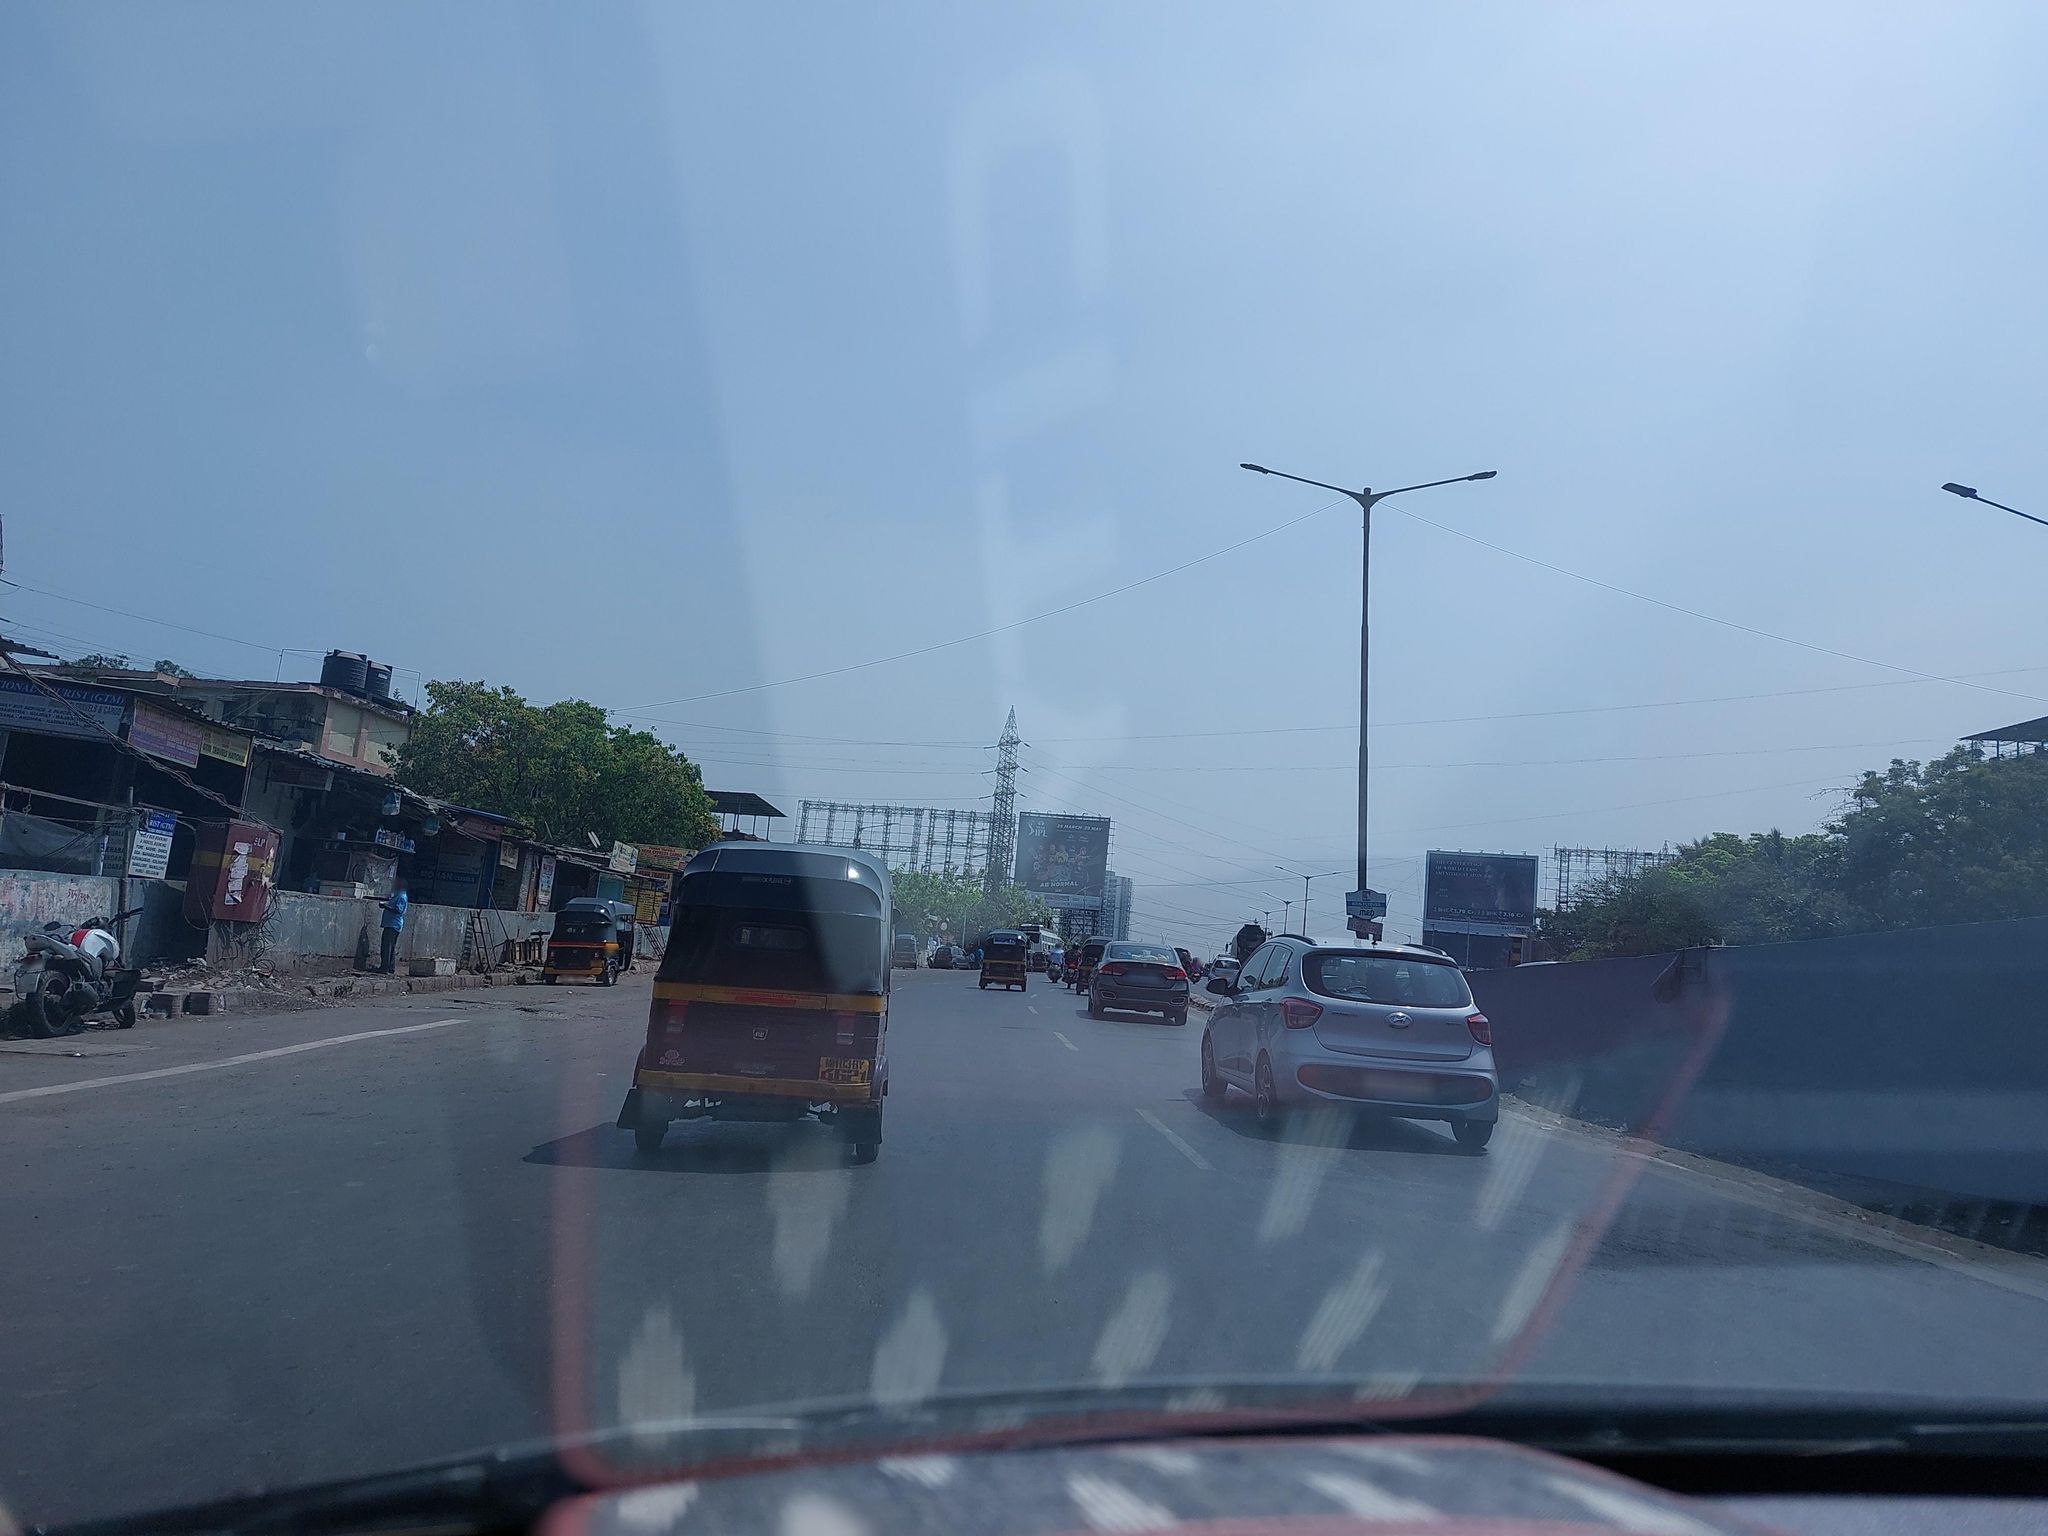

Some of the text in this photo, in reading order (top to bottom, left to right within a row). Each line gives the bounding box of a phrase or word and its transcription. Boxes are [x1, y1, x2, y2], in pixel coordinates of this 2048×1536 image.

[1063, 823, 1083, 831] MARCH
[1035, 829, 1047, 837] IPL
[1050, 880, 1079, 889] NORMAL
